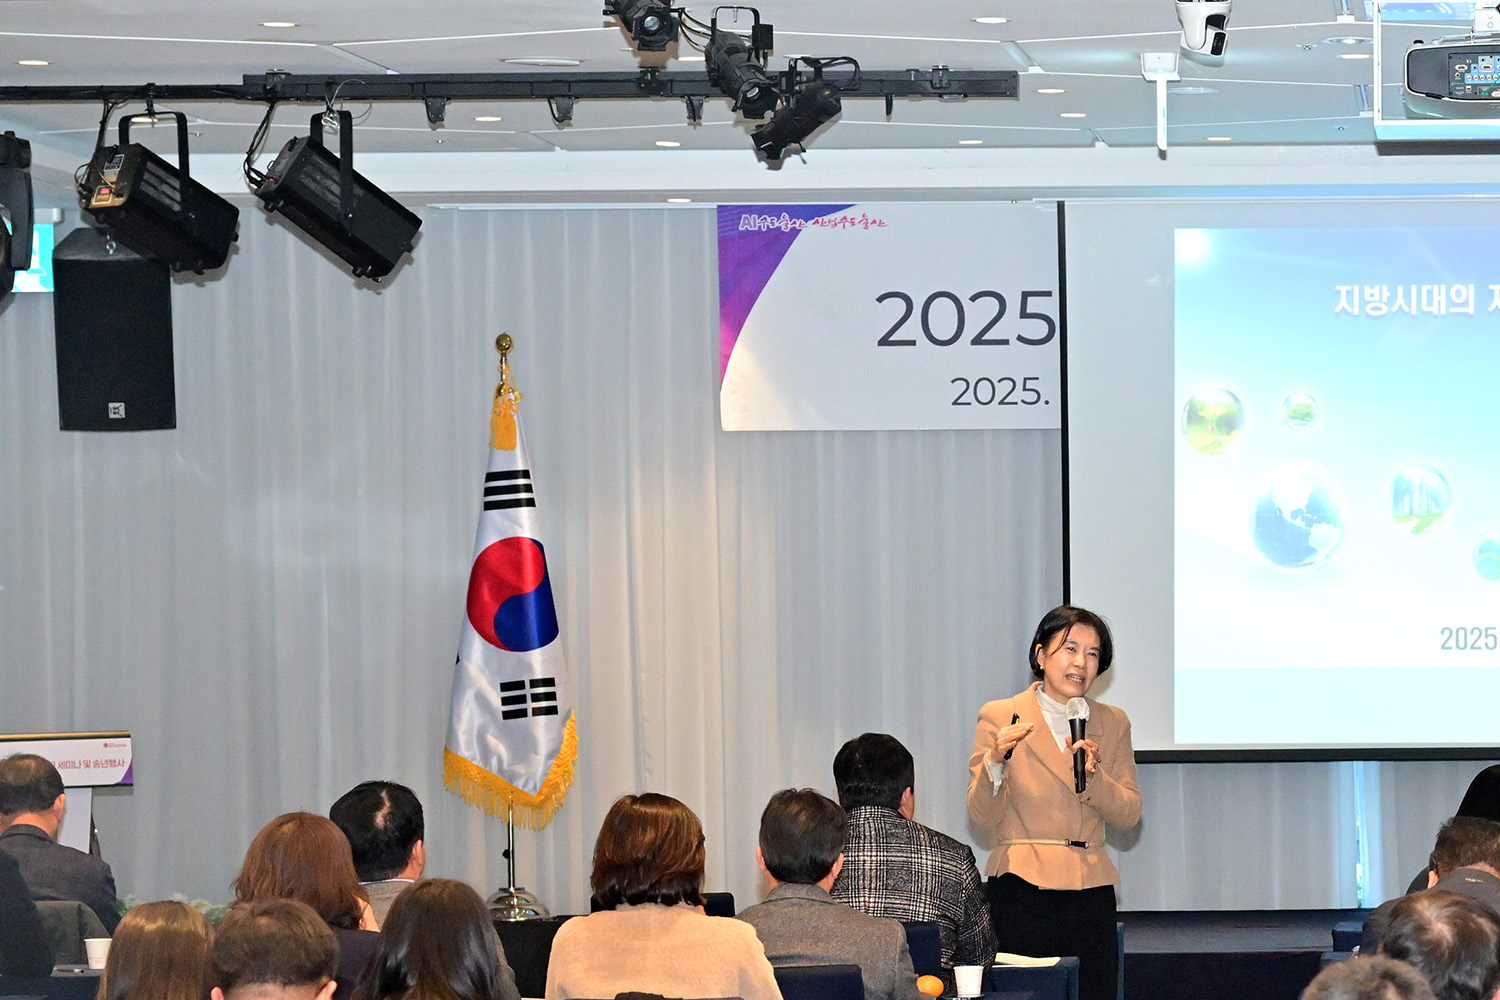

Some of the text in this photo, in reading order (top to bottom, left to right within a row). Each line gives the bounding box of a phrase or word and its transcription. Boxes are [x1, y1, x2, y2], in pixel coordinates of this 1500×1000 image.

[1334, 283, 1475, 317] 지방시대의
[875, 290, 1056, 347] 2025
[950, 376, 1050, 406] 2025.
[58, 759, 82, 770] 세미나
[83, 759, 91, 769] 및
[92, 758, 125, 769] 송년행사
